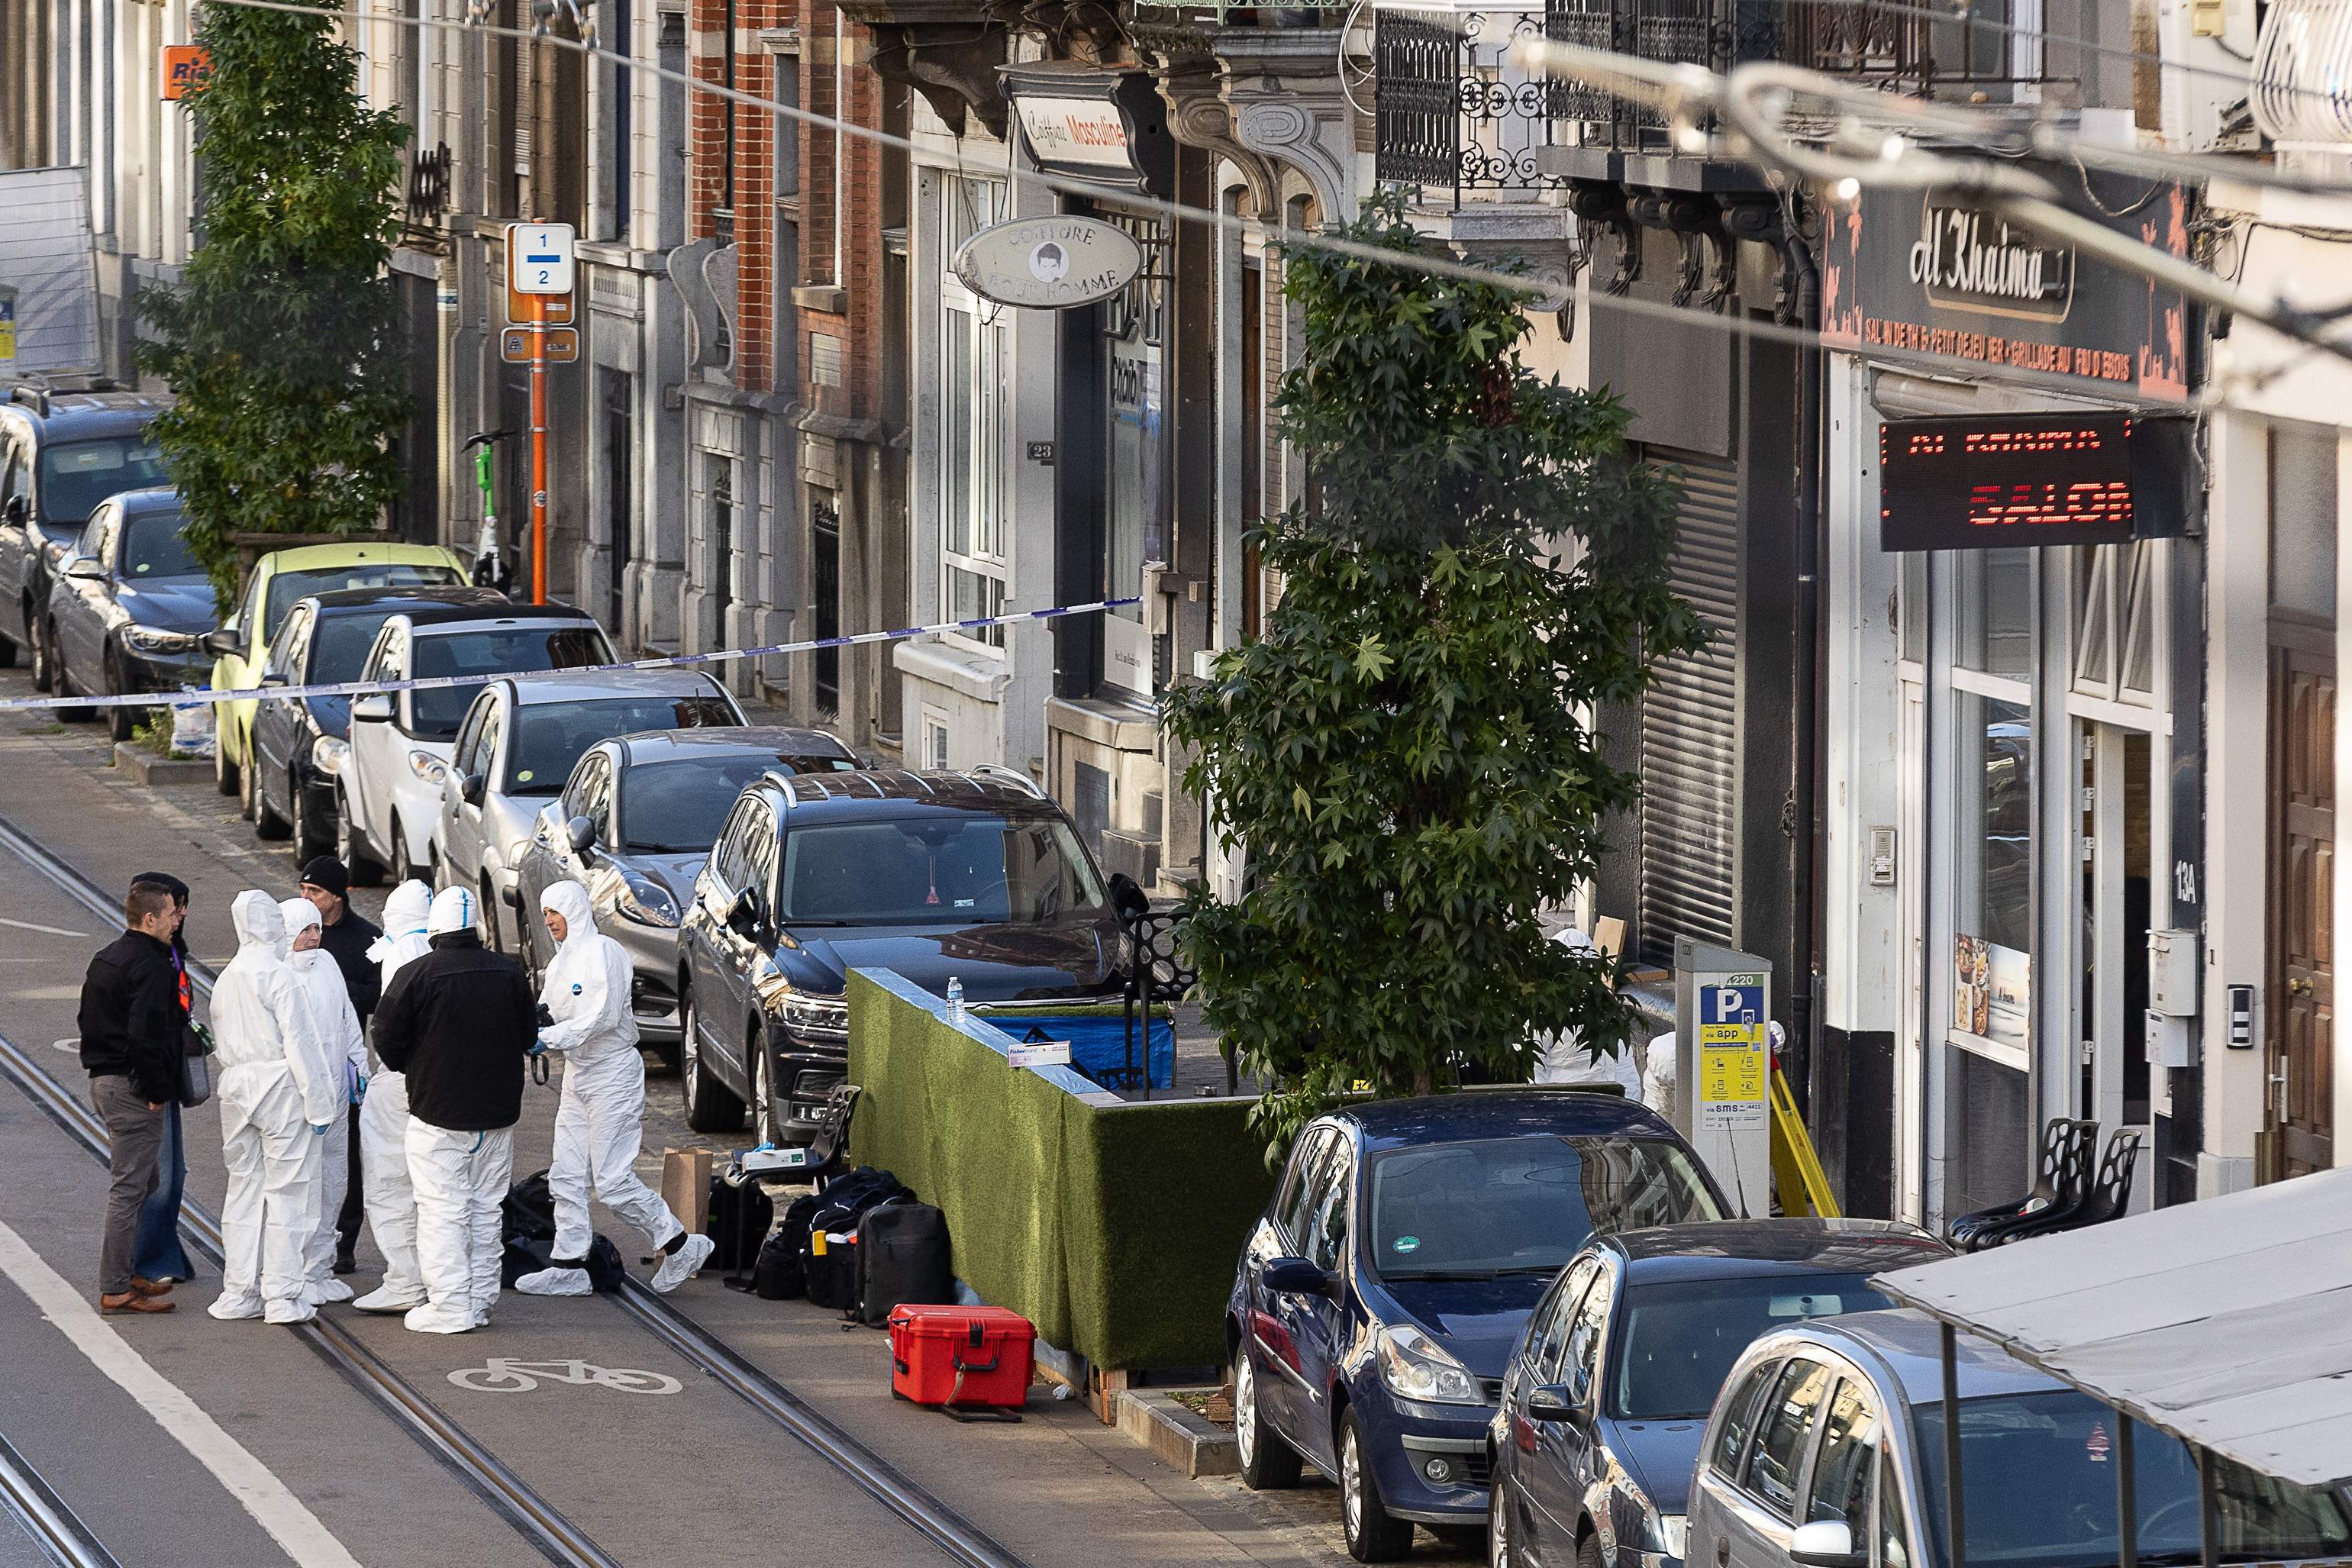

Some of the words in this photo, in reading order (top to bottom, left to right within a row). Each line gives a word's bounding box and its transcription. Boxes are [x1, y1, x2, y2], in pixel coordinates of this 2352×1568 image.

[1066, 115, 1127, 147] Masculine
[539, 234, 547, 247] 1
[1946, 208, 2045, 299] Khaima
[538, 270, 549, 284] 2
[1046, 269, 1120, 300] HOMME
[1931, 328, 1957, 355] PETIT
[2012, 340, 2057, 373] GRILLADE
[2057, 346, 2071, 373] AU
[1034, 445, 1051, 458] 23
[2175, 860, 2196, 904] 13A
[1717, 989, 1743, 1022] P
[1717, 1030, 1738, 1039] app
